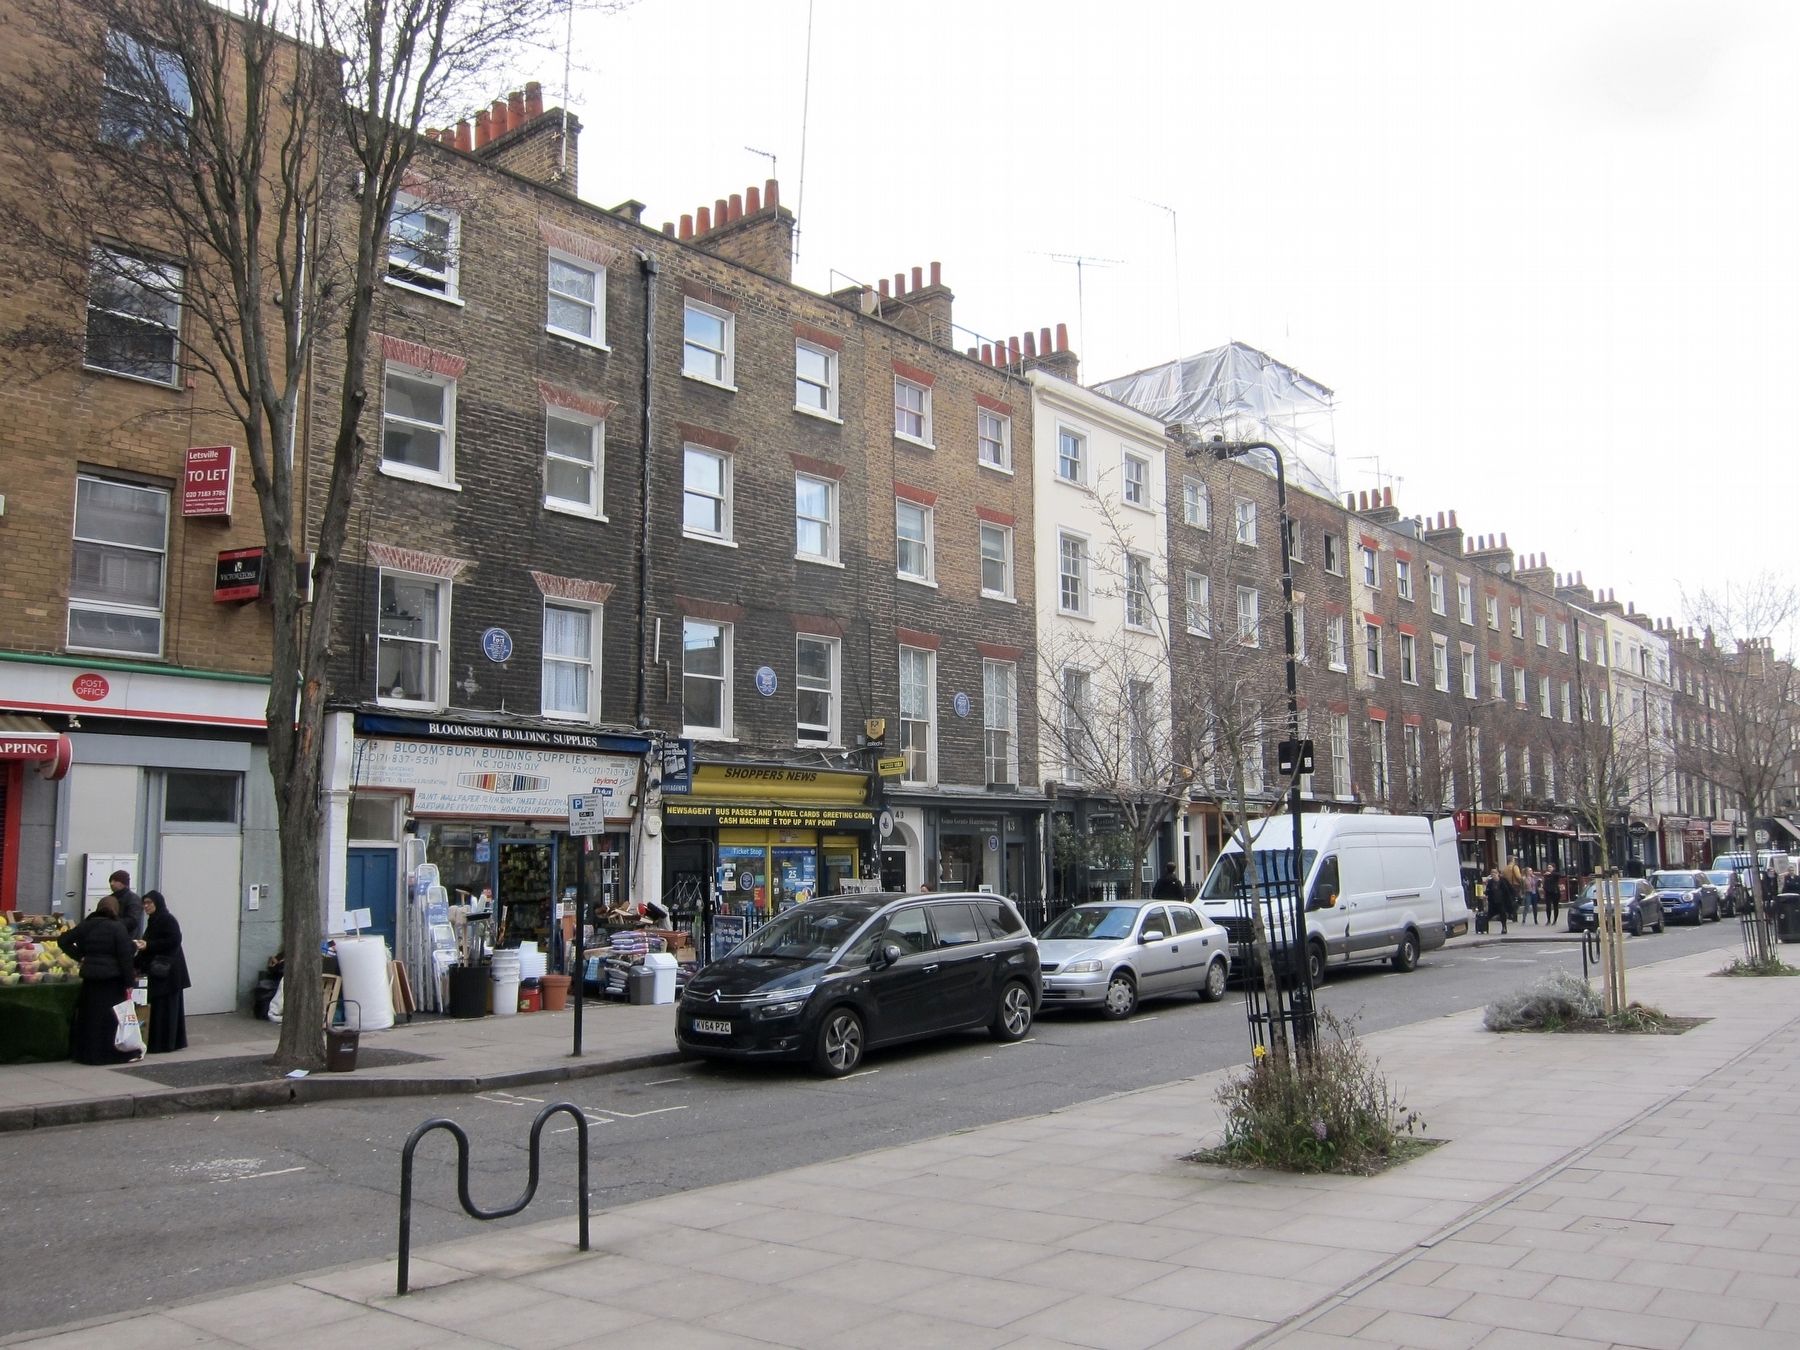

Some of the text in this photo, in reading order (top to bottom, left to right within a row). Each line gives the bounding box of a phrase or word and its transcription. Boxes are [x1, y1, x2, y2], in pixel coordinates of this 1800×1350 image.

[189, 450, 219, 460] Letsville
[188, 469, 228, 482] TO LET
[80, 679, 104, 688] POST
[75, 687, 106, 697] OFFICE
[428, 722, 598, 747] BLOOMSBURY BUILDING SUPPLIES
[394, 742, 478, 758] BLOOMSBURY
[482, 748, 532, 762] BUILDING
[536, 752, 588, 765] SUPPLIES
[472, 760, 489, 769] INC
[491, 760, 522, 770] JOHNS
[724, 767, 818, 782] SHOPPERS NEWS
[593, 776, 619, 786] Leyland
[575, 799, 582, 809] P
[666, 806, 712, 815] NEWSAGENT
[731, 808, 757, 816] PASSES
[758, 809, 772, 817] AND
[773, 809, 798, 818] TRAVEL
[799, 810, 820, 818] CARDS
[822, 811, 853, 819] GREETING
[853, 811, 873, 820] CARDS
[895, 810, 904, 819] 43
[718, 816, 738, 825] CASH
[739, 817, 769, 826] MACHINE
[778, 818, 792, 826] TOP
[792, 818, 802, 826] UP
[804, 818, 817, 826] PAY
[817, 819, 837, 827] POINT
[732, 847, 750, 855] Ticket
[750, 848, 763, 856] Stop
[788, 870, 797, 879] 25
[715, 1022, 730, 1033] PZC
